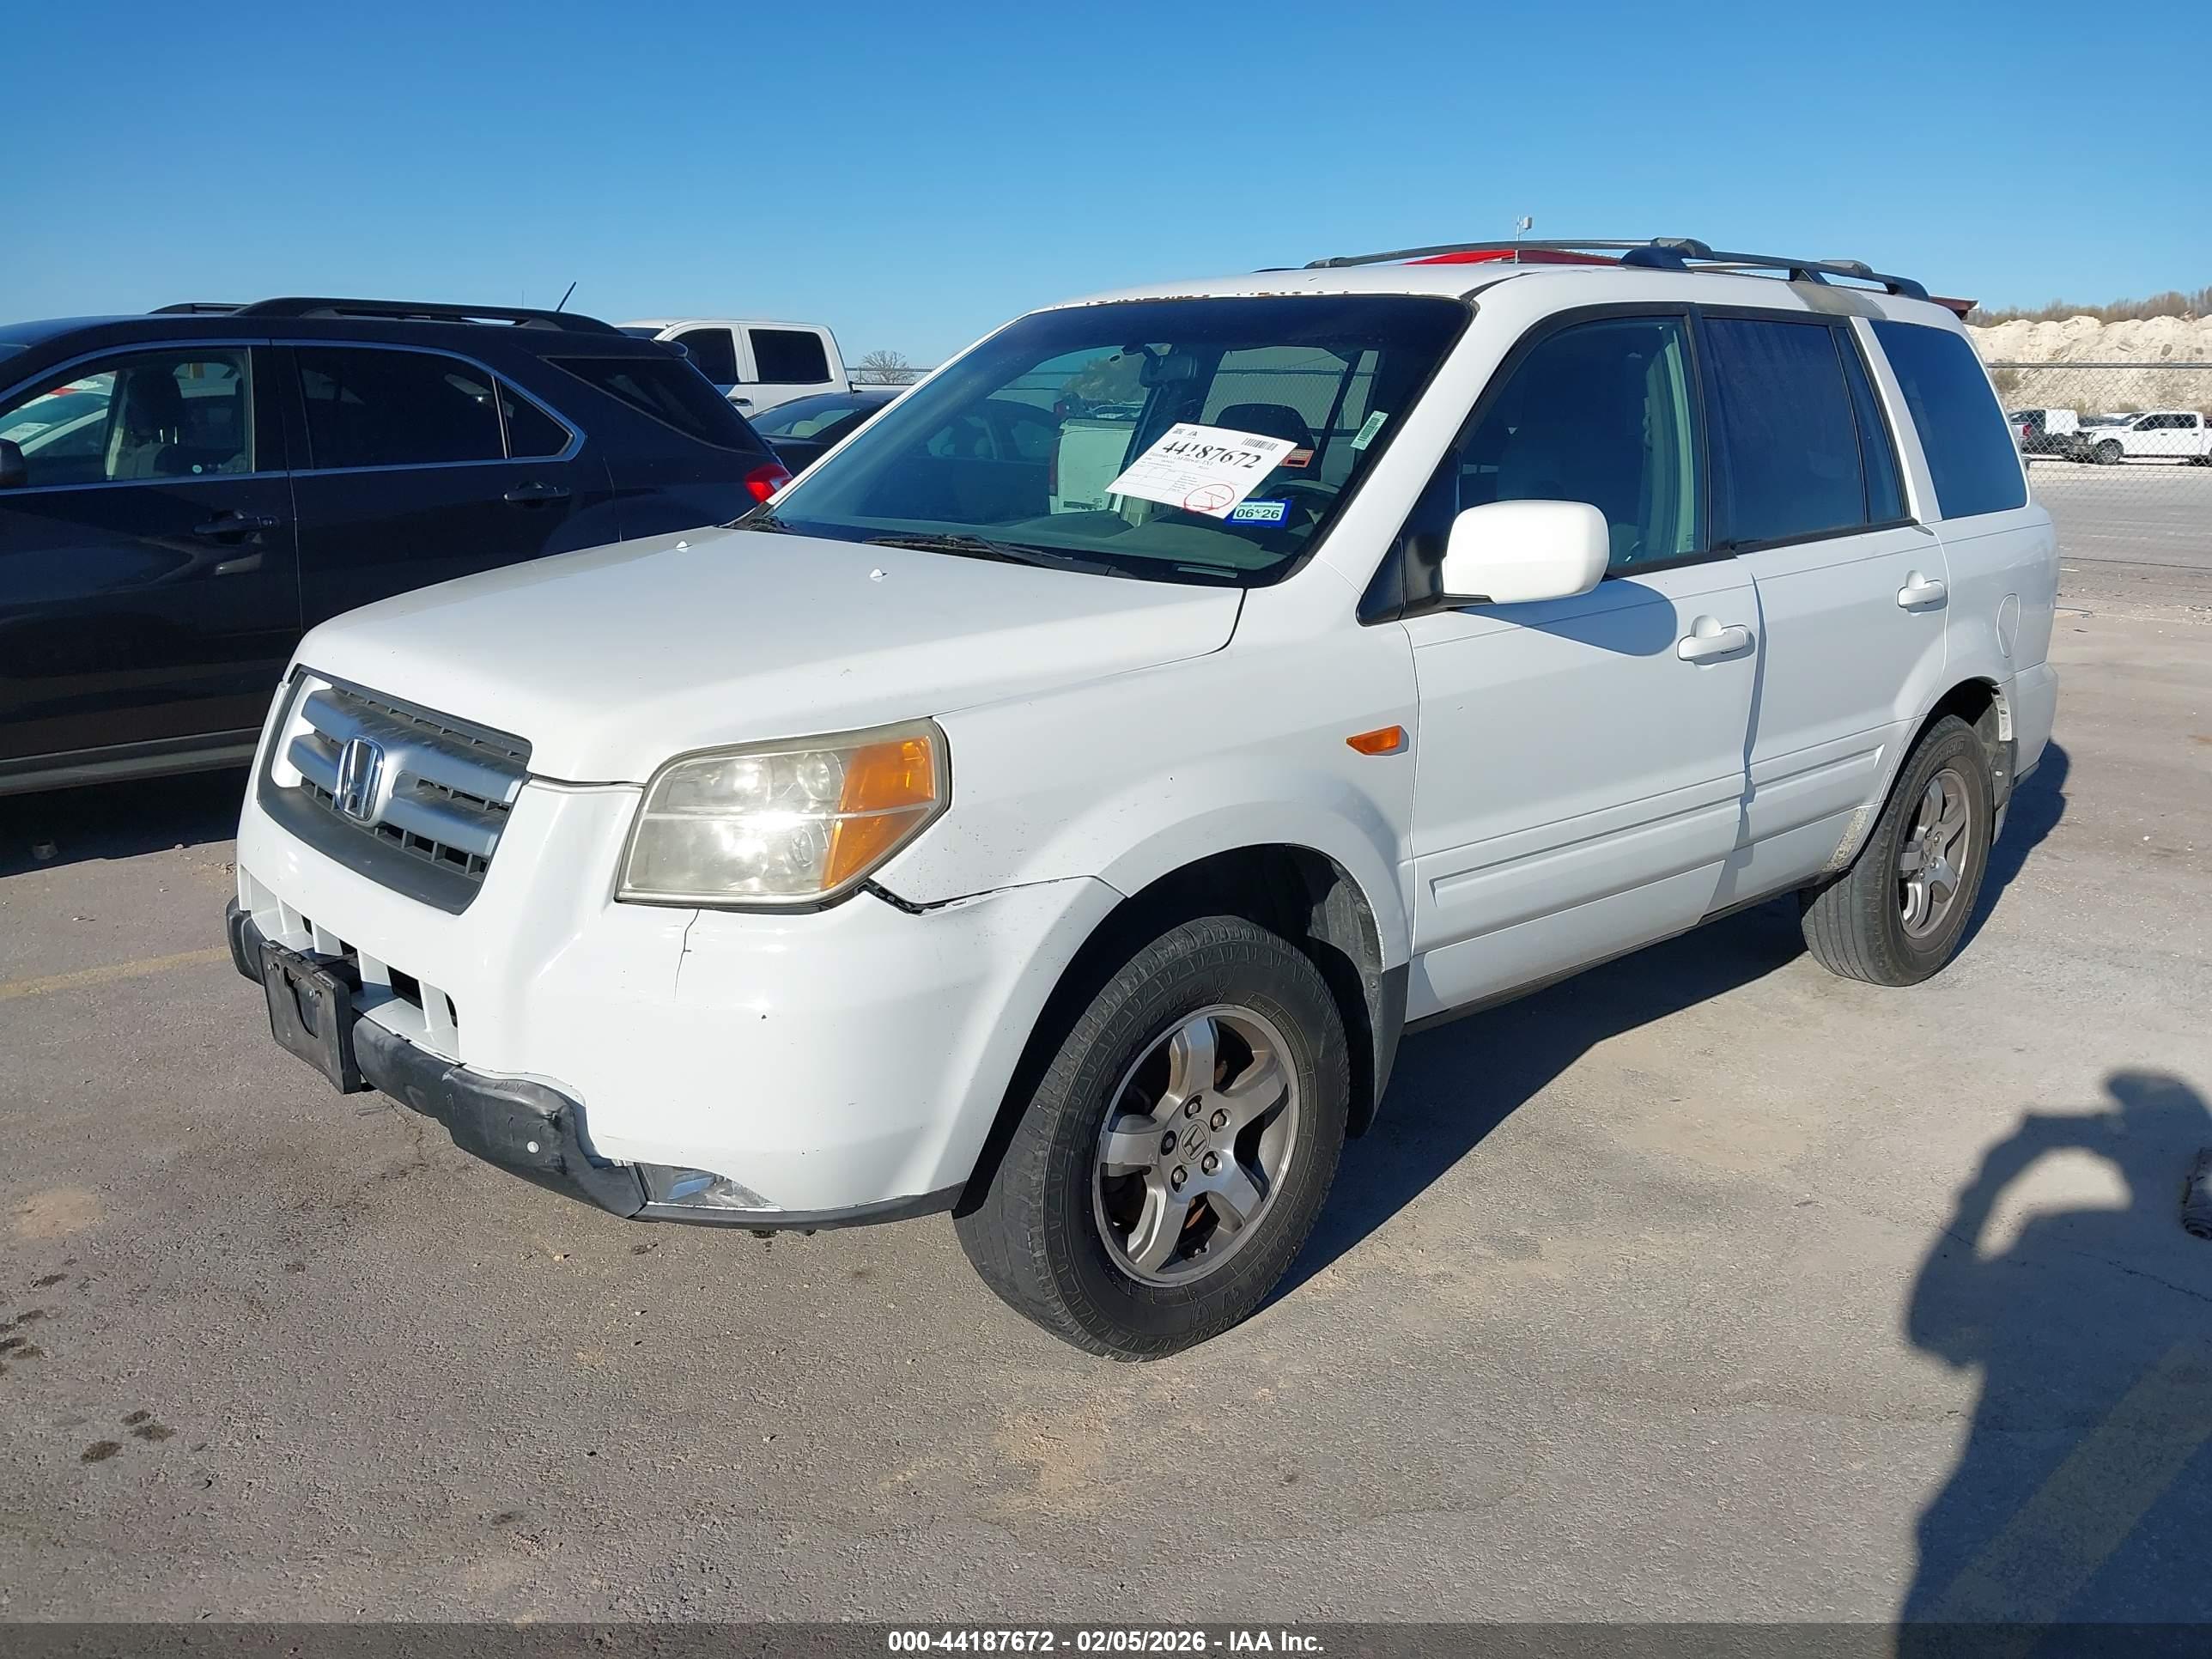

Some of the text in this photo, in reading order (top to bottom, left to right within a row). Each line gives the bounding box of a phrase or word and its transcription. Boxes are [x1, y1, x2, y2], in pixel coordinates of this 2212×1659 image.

[1163, 441, 1261, 469] 44187672
[1237, 508, 1280, 519] 06 26
